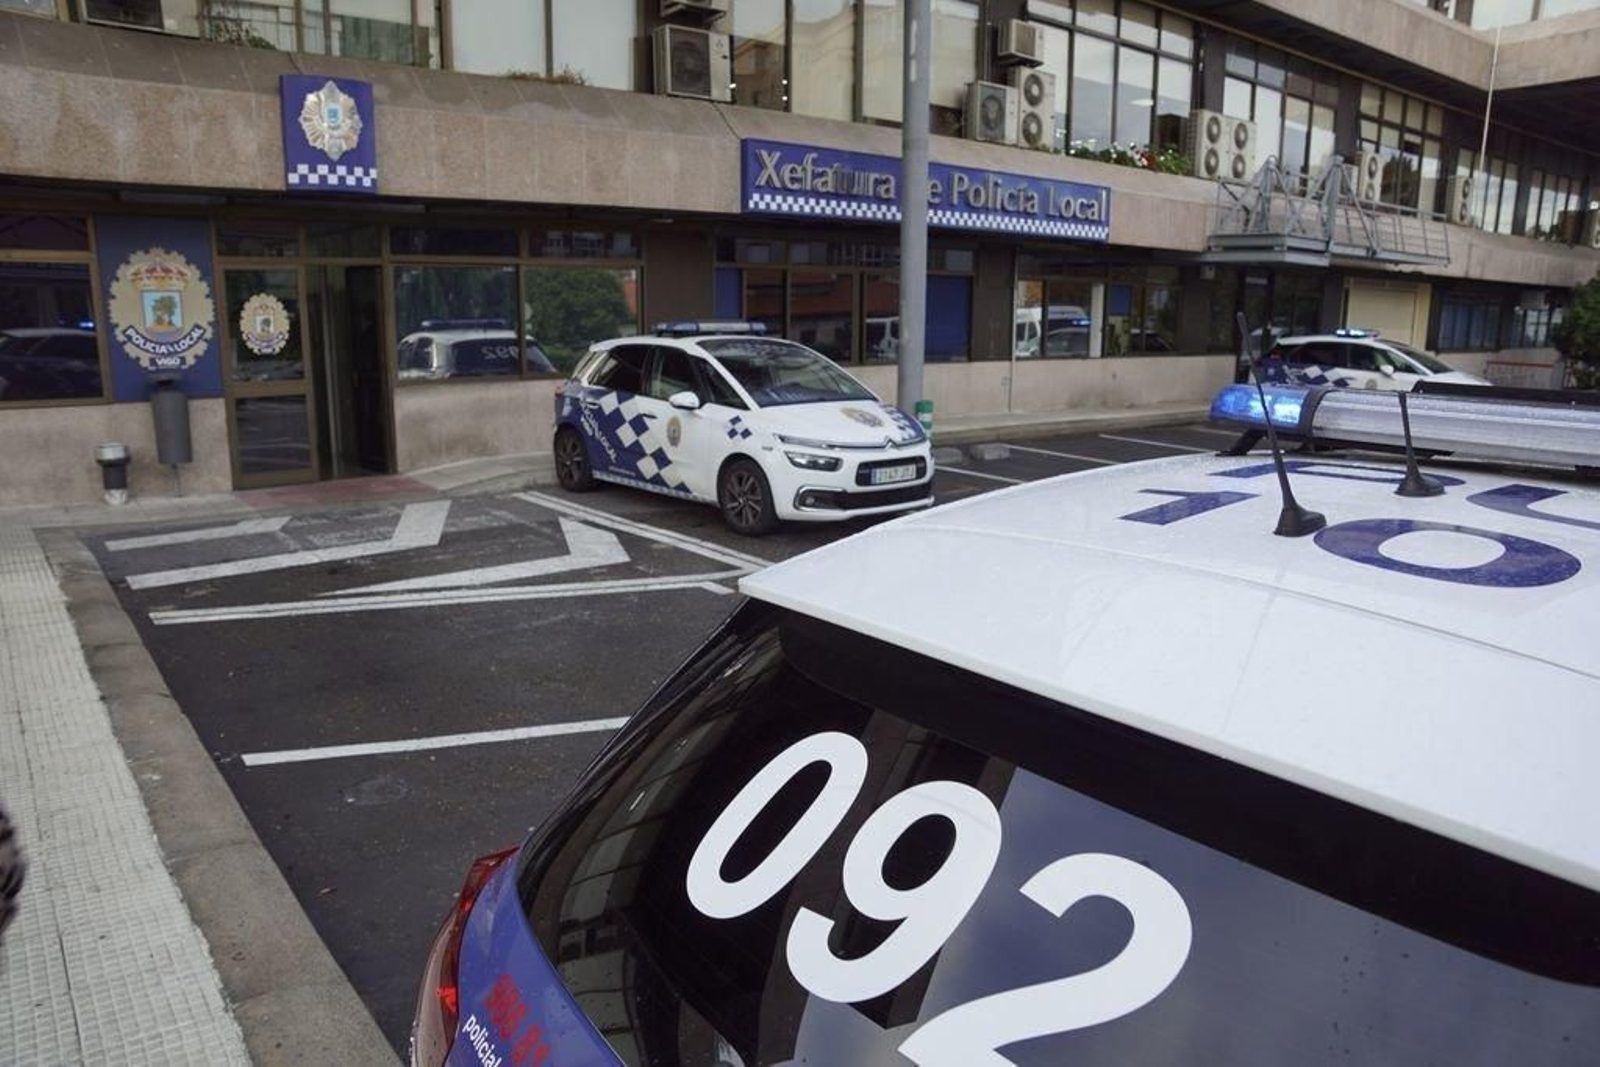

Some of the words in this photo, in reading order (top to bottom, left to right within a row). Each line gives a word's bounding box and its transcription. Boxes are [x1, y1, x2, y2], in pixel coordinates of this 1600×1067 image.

[755, 150, 896, 199] Xefatura
[927, 178, 942, 204] e
[952, 172, 1038, 214] Policía
[1047, 187, 1106, 221] Local
[155, 356, 181, 366] VIGO
[174, 326, 204, 352] LOCAL
[685, 730, 1193, 1067] 092
